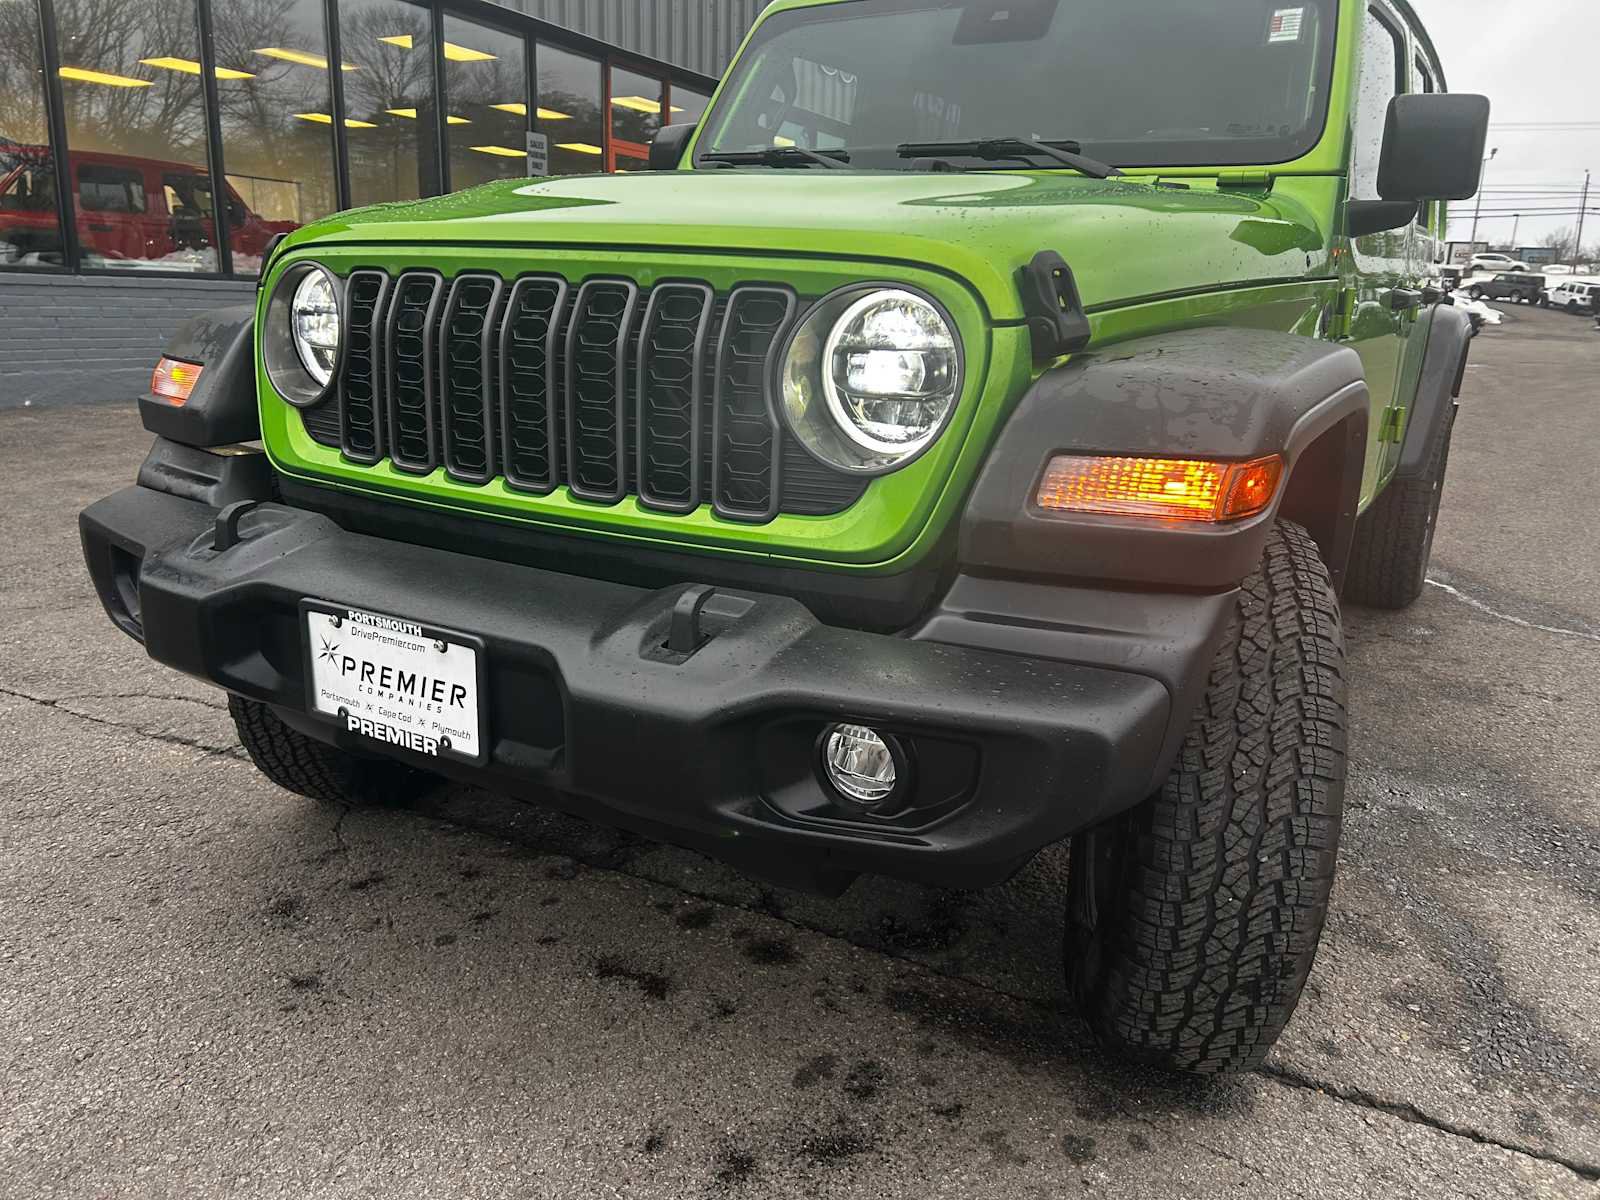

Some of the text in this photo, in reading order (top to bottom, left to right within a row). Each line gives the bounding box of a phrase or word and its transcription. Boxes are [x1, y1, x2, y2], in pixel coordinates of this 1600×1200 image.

[347, 610, 422, 637] PORTSMOUTH
[351, 626, 426, 653] DrivePremier.com
[341, 655, 467, 709] PREMIER
[358, 684, 442, 713] COMPANIES
[321, 688, 471, 741] Portsmouth Cape Cod Plymouth
[346, 714, 439, 757] PREMIER
